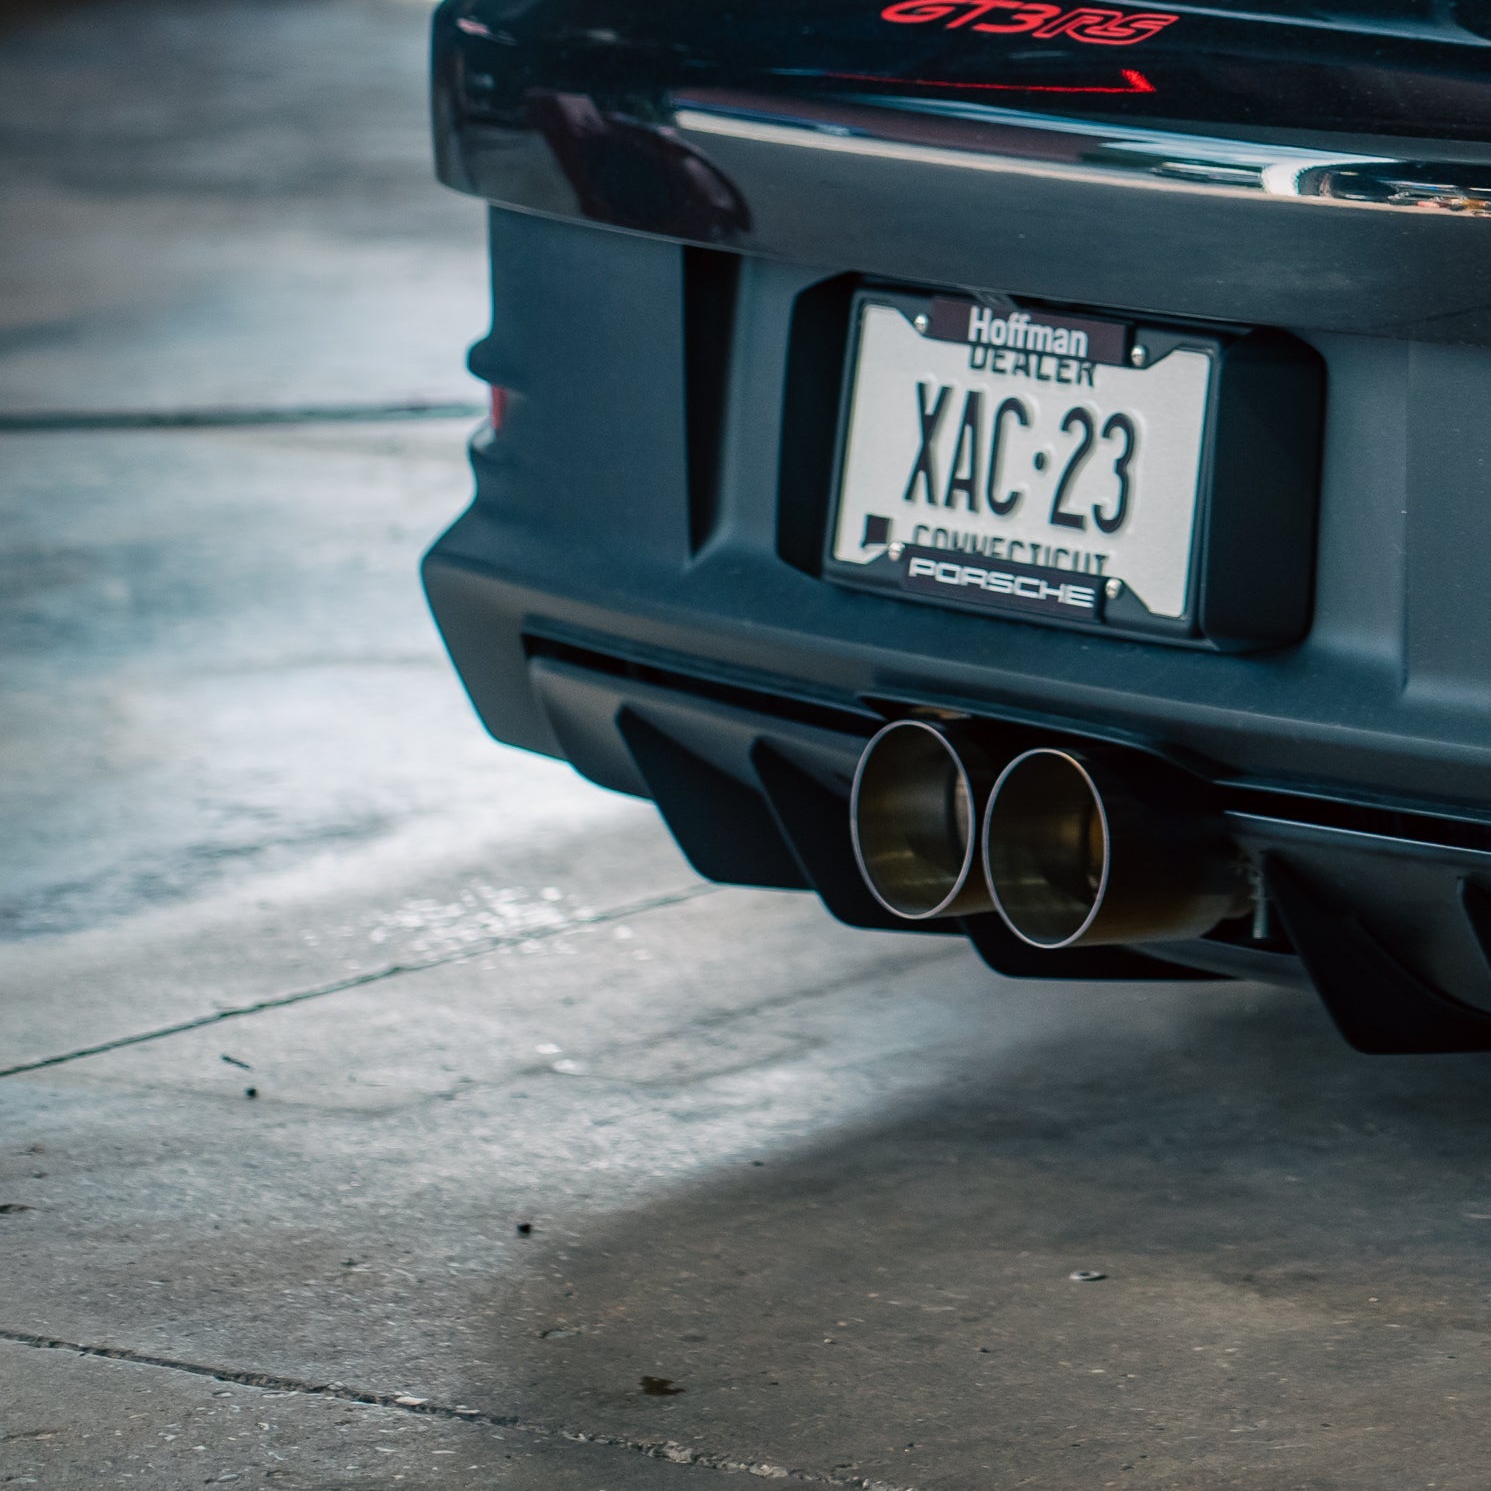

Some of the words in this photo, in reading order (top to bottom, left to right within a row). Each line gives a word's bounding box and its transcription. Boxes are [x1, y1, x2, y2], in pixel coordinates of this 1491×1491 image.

[968, 306, 1088, 358] Hoffman
[969, 346, 1095, 387] DEALER
[908, 557, 1096, 608] PORSCHE
